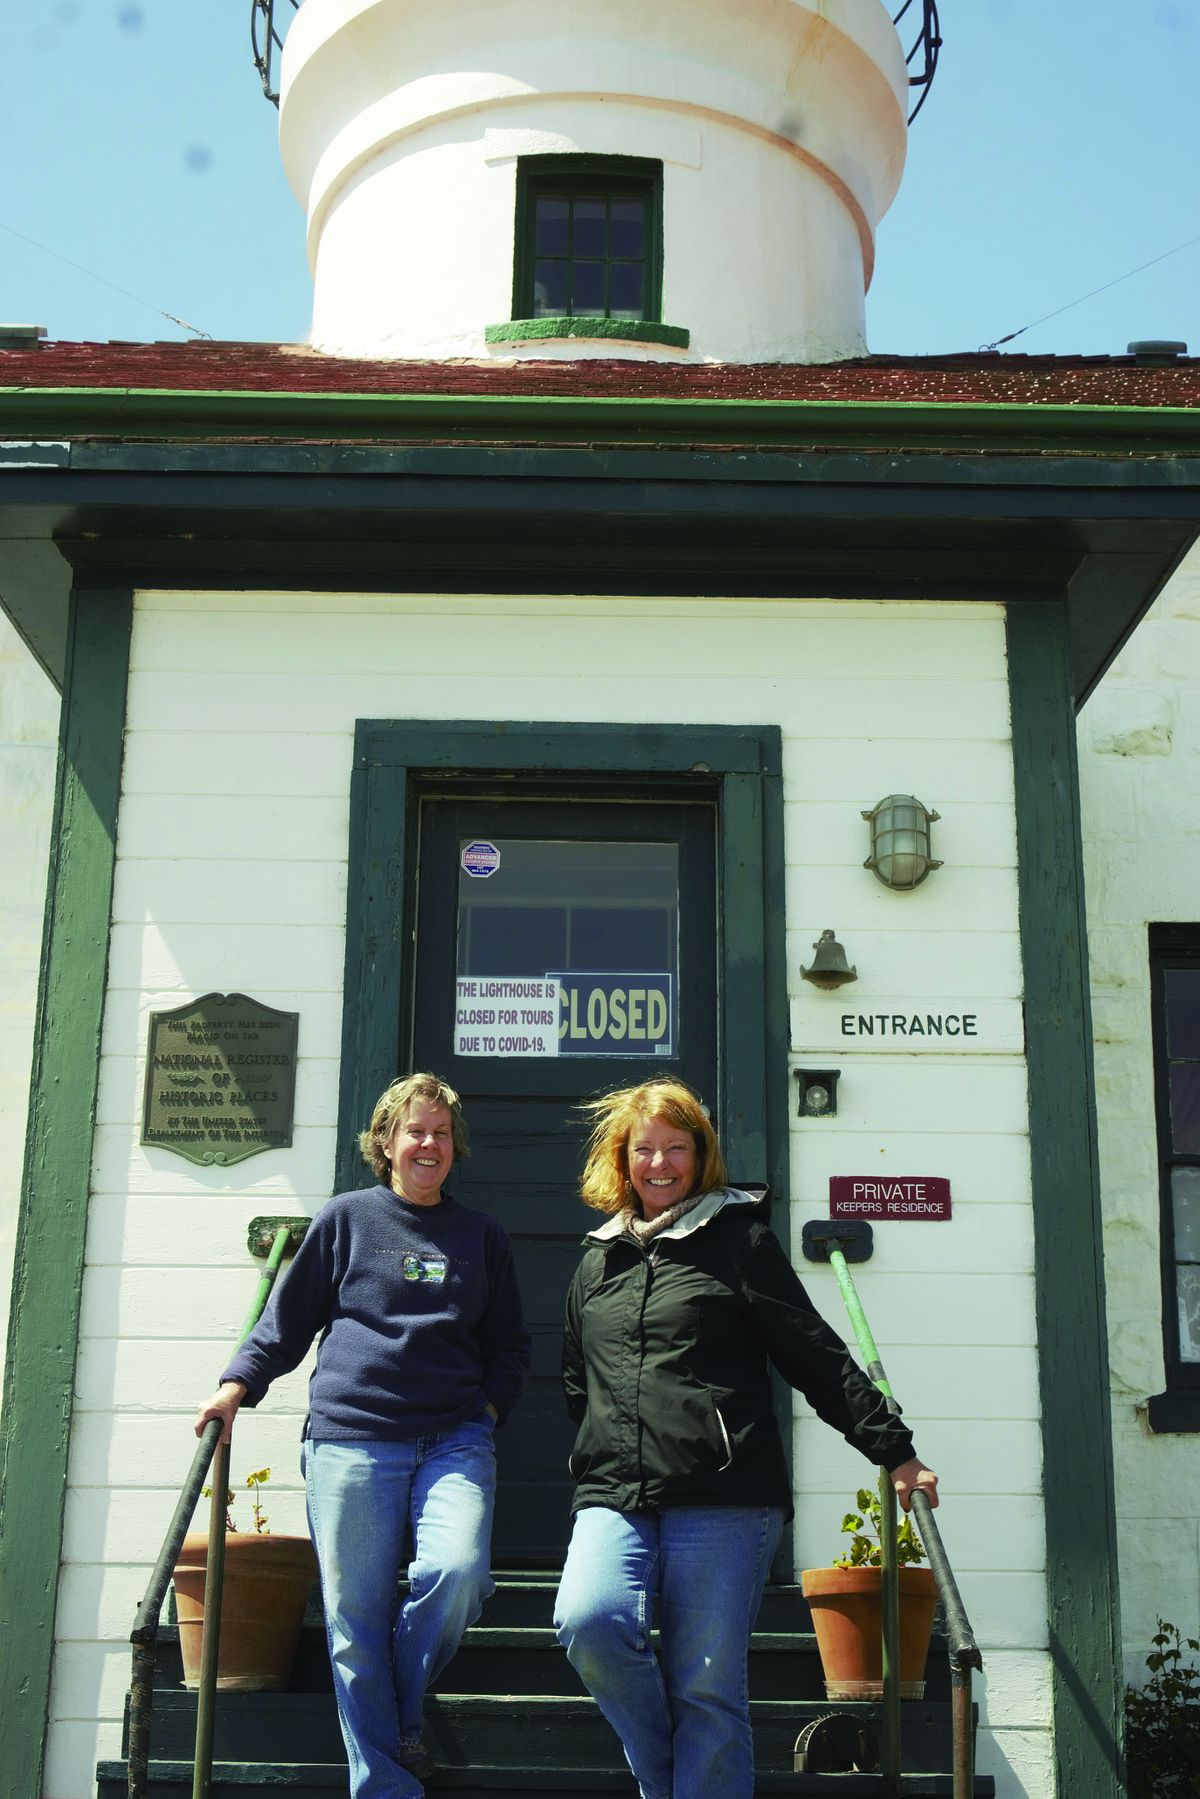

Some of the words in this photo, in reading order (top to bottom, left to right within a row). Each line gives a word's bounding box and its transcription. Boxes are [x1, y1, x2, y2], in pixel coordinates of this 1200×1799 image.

[457, 982, 477, 998] THE
[479, 982, 543, 998] LIGHTHOUSE
[545, 983, 555, 998] IS
[456, 1009, 496, 1025] CLOSED
[498, 1009, 518, 1025] FOR
[520, 1010, 554, 1025] TOURS
[841, 1014, 978, 1036] ENTRANCE
[223, 1032, 239, 1041] ON
[459, 1036, 480, 1052] DUE
[482, 1036, 496, 1052] TO
[498, 1036, 546, 1052] COVID-19.
[154, 1054, 222, 1066] NATIONAL
[227, 1054, 290, 1067] REGISTER
[211, 1072, 231, 1085] OF
[159, 1090, 224, 1103] HISTORIC
[229, 1090, 278, 1103] PLACES
[853, 1183, 927, 1201] PRIVATE
[836, 1202, 883, 1213] KEEPERS
[887, 1203, 944, 1213] RESIDENCE
